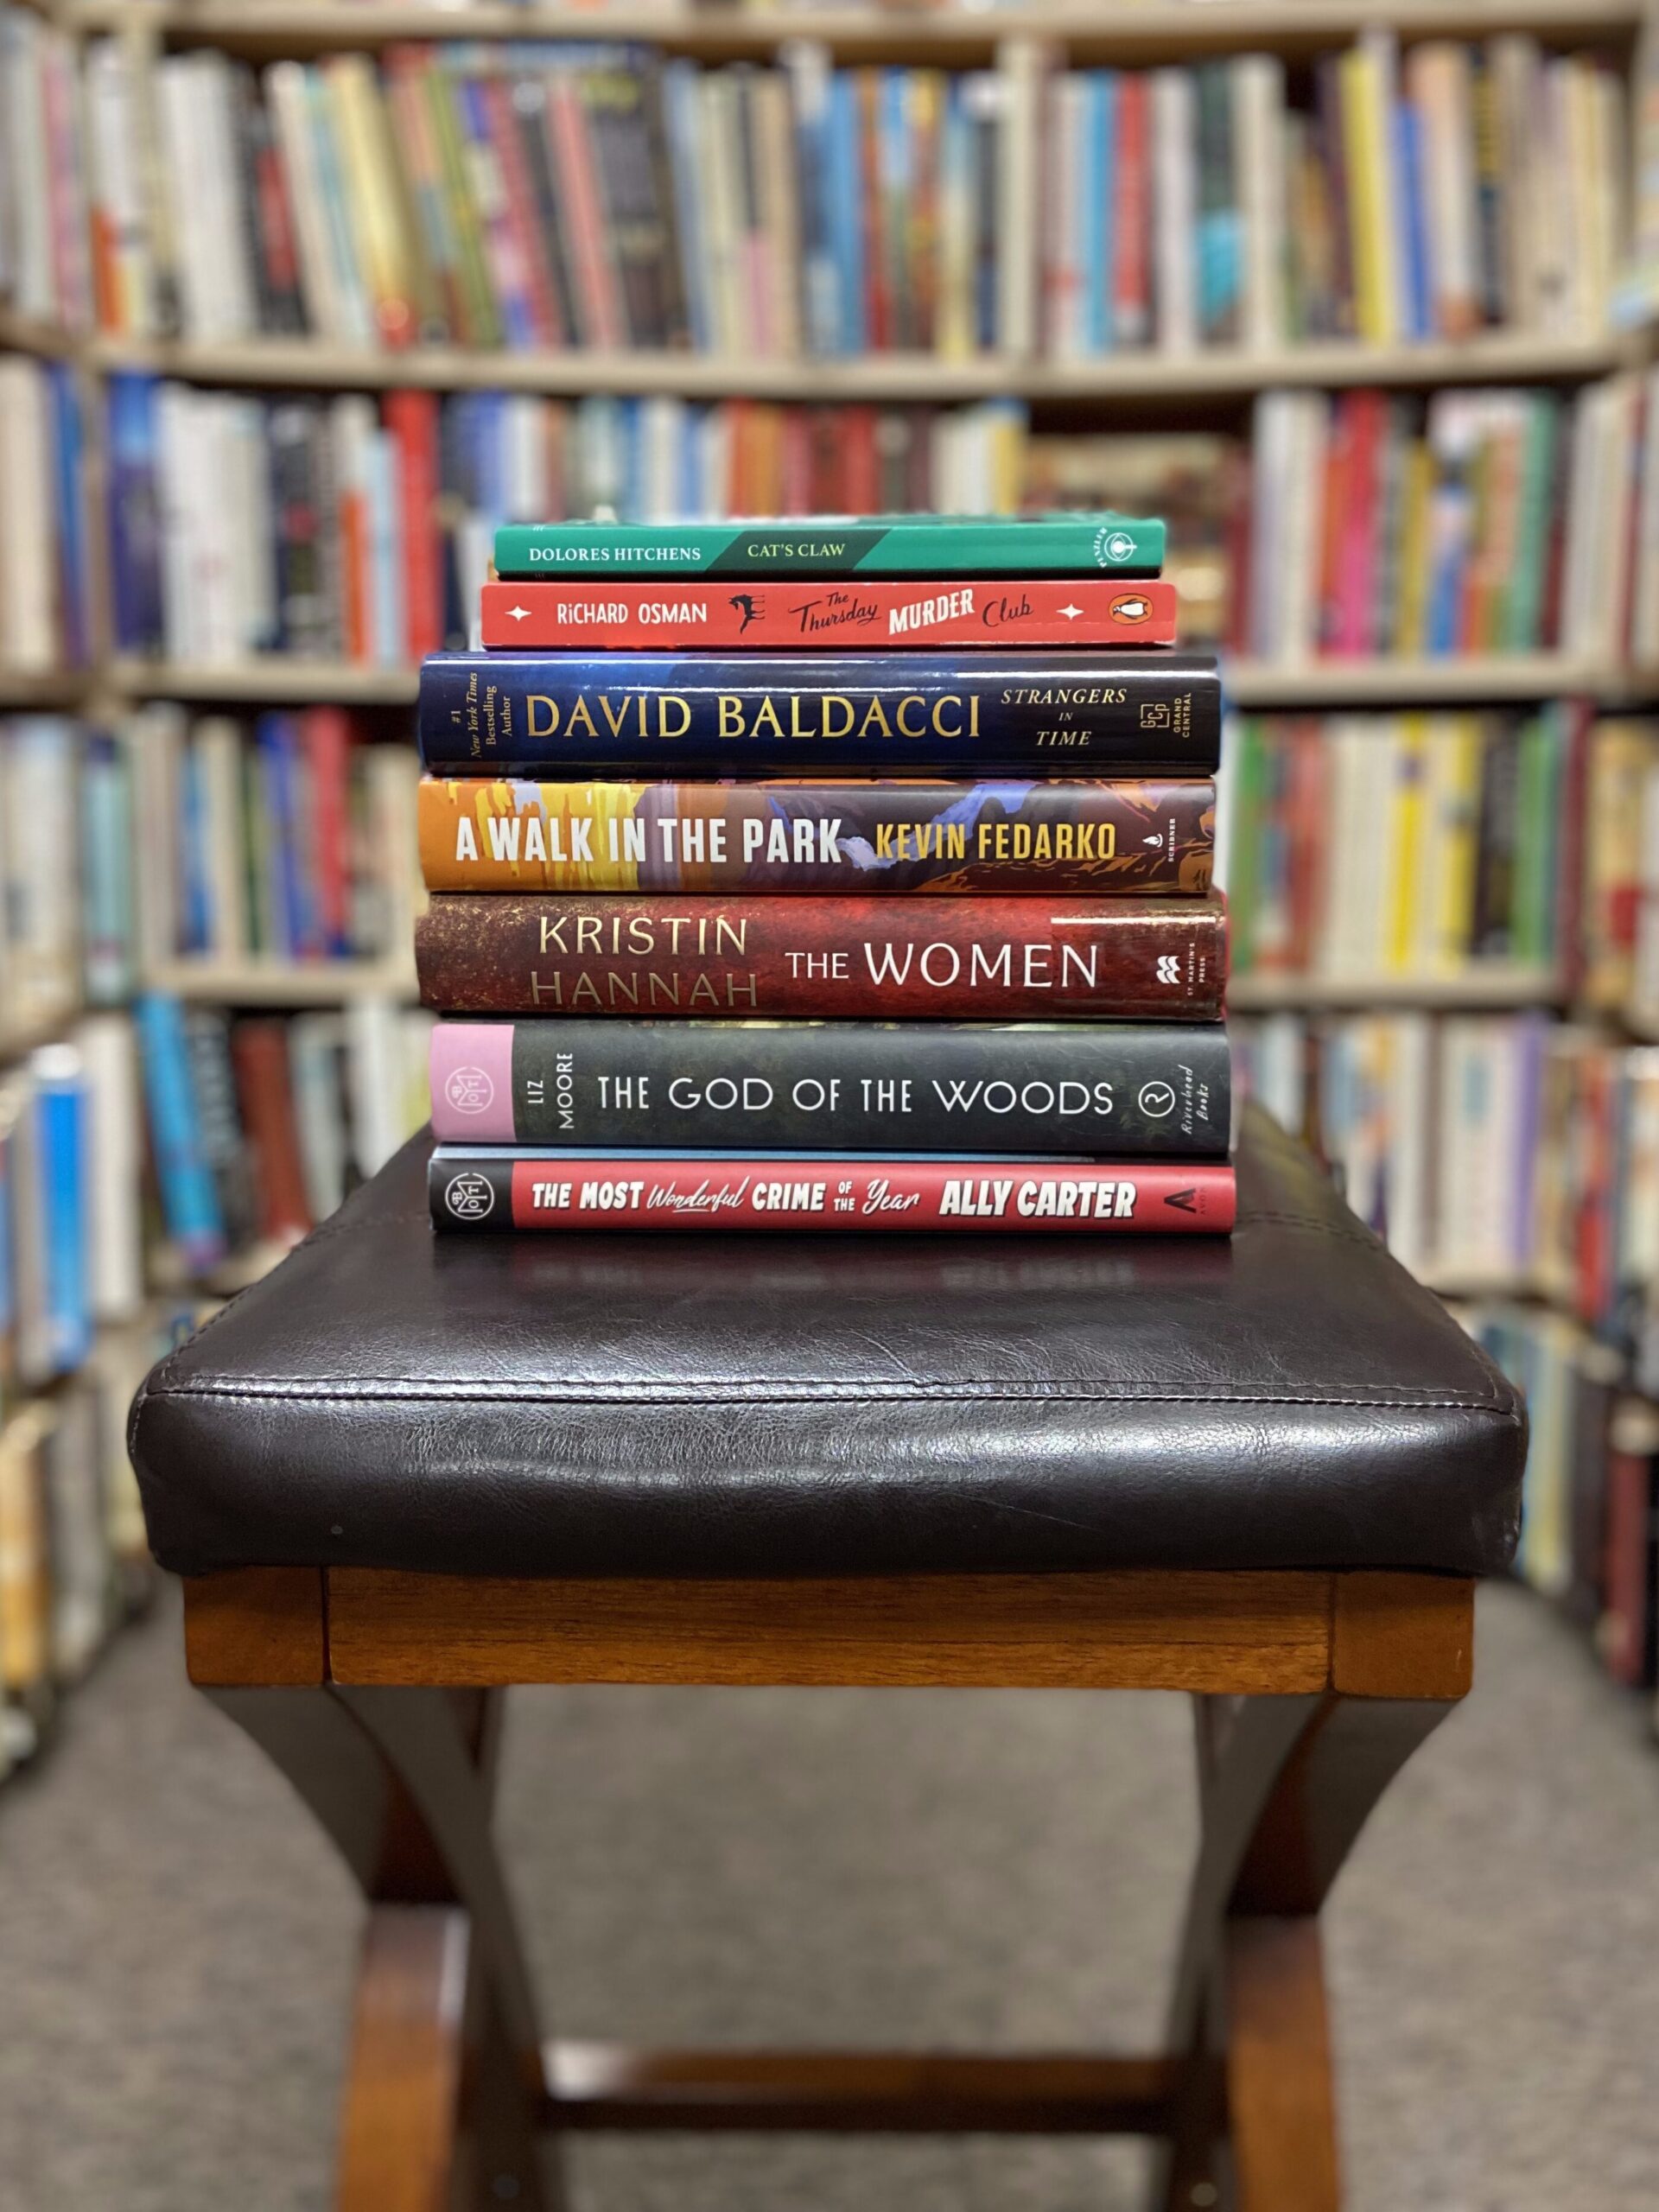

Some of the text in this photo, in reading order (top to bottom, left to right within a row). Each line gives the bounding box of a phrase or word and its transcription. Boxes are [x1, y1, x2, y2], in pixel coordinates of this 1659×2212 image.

[529, 547, 702, 562] DOLORES HITCHENS
[747, 543, 846, 557] CAT'S CLAW
[639, 603, 708, 625] OSMAN
[788, 599, 882, 633] Thursday
[825, 591, 849, 606] The
[888, 588, 975, 635] MURDER
[982, 594, 1033, 627] Club
[467, 671, 482, 759] New York Times
[483, 685, 498, 745] Bestselling
[1001, 688, 1128, 705] STRANGERS
[1182, 692, 1192, 738] CENTRAL
[451, 710, 461, 723] #1
[500, 696, 512, 737] Author
[525, 695, 980, 738] DAVID BALDACCI
[1058, 712, 1073, 721] IN
[1173, 697, 1182, 734] GRAND
[1036, 731, 1092, 746] TIME
[455, 817, 842, 864] A WALK IN THE PARK
[876, 823, 1116, 860] KEVIN FEDARKO
[539, 916, 747, 956] KRISTIN
[785, 942, 1097, 988] THE WOMEN
[531, 970, 758, 1007] HANNAH
[527, 1079, 544, 1104] LIZ
[556, 1052, 575, 1128] MOORE
[598, 1076, 1114, 1116] THE GOD OF THE WOODS
[1178, 1064, 1194, 1135] Riverhead
[1196, 1083, 1210, 1121] Books
[531, 1175, 826, 1213] THE MOST Wonderful CRIME
[833, 1198, 855, 1211] THE
[838, 1181, 853, 1193] OF
[861, 1178, 920, 1214] Year
[938, 1180, 1137, 1218] ALLY CARTER
